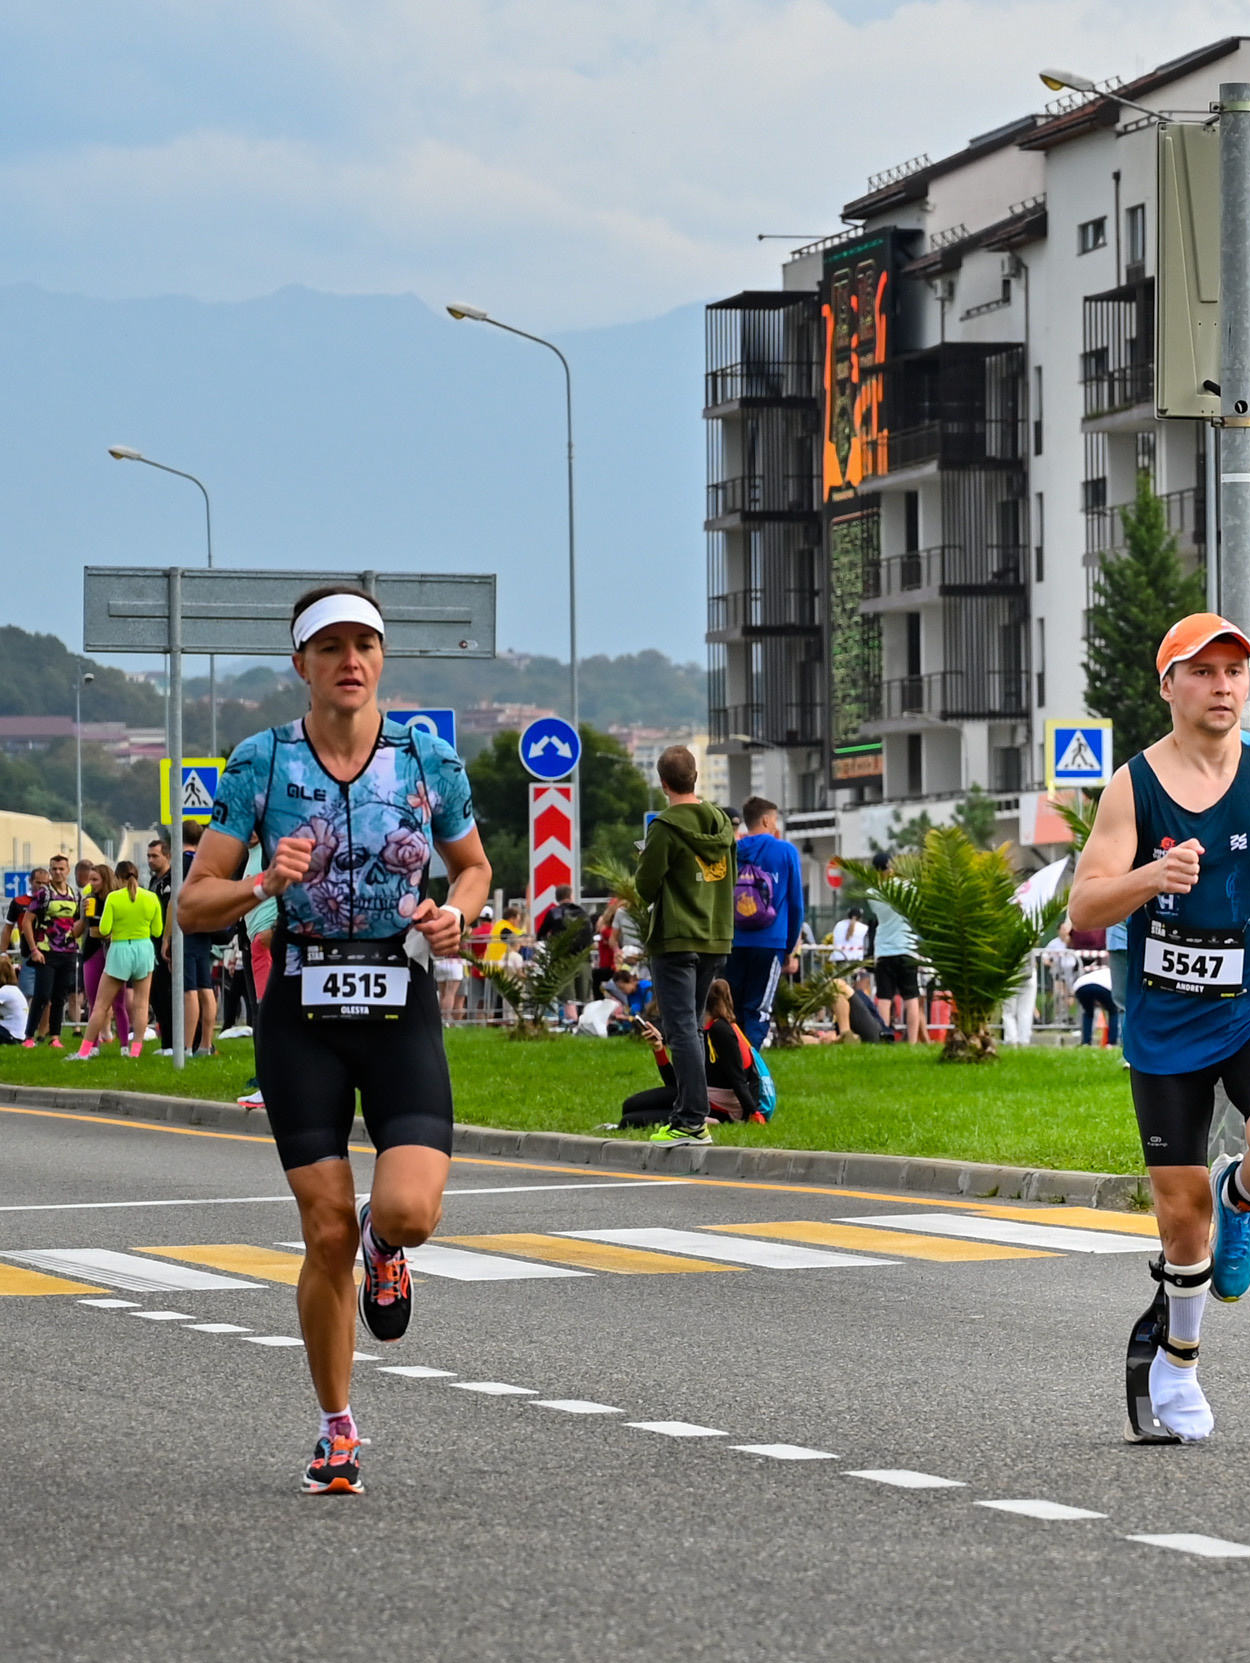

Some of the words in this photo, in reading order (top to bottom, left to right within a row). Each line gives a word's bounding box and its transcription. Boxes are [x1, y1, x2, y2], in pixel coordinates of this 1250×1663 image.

[1162, 949, 1224, 979] 5547
[323, 972, 387, 999] 4515
[1176, 982, 1204, 993] ANDREY
[340, 1005, 370, 1015] OLESYA
